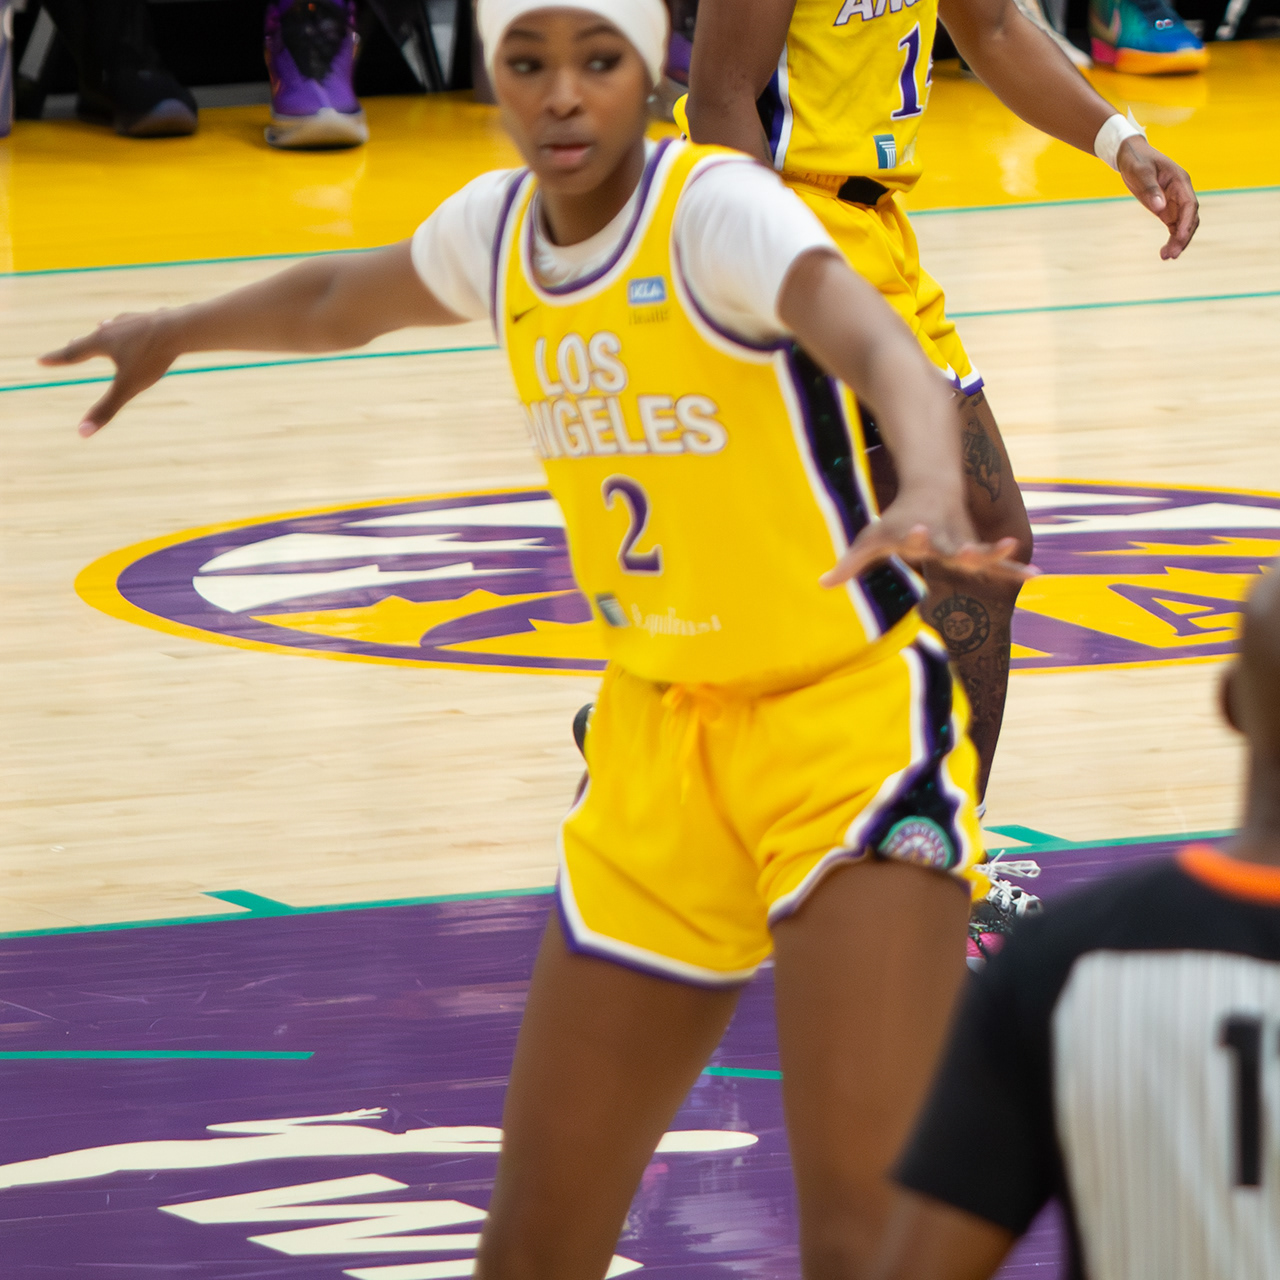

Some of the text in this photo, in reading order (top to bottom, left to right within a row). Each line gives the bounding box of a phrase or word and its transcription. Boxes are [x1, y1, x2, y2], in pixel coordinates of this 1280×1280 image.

[533, 329, 629, 397] LOS
[522, 393, 729, 460] NGELES
[600, 472, 665, 578] 2
